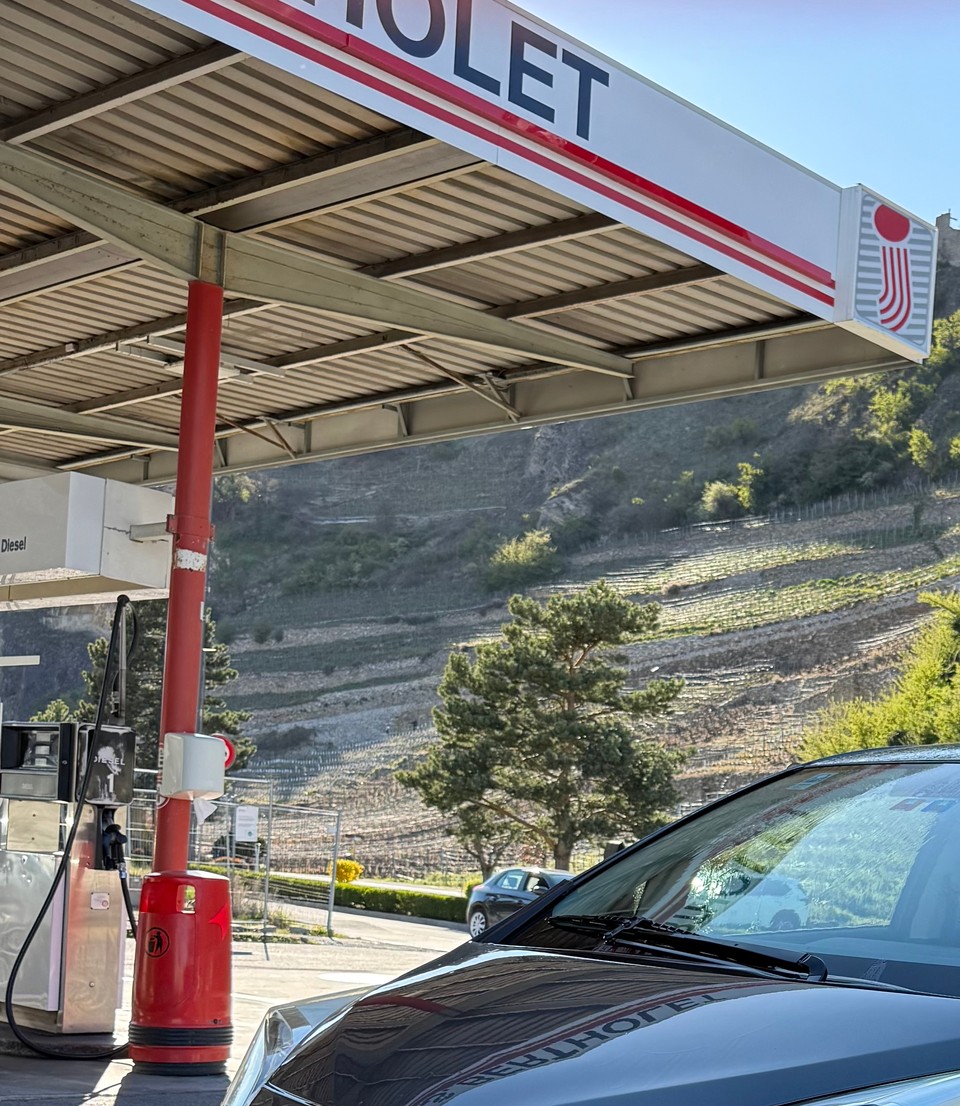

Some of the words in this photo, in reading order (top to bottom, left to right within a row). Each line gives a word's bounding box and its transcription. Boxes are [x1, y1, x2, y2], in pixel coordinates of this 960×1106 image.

[297, 0, 609, 141] OLET
[1, 535, 27, 553] Diesel
[107, 773, 114, 793] 1
